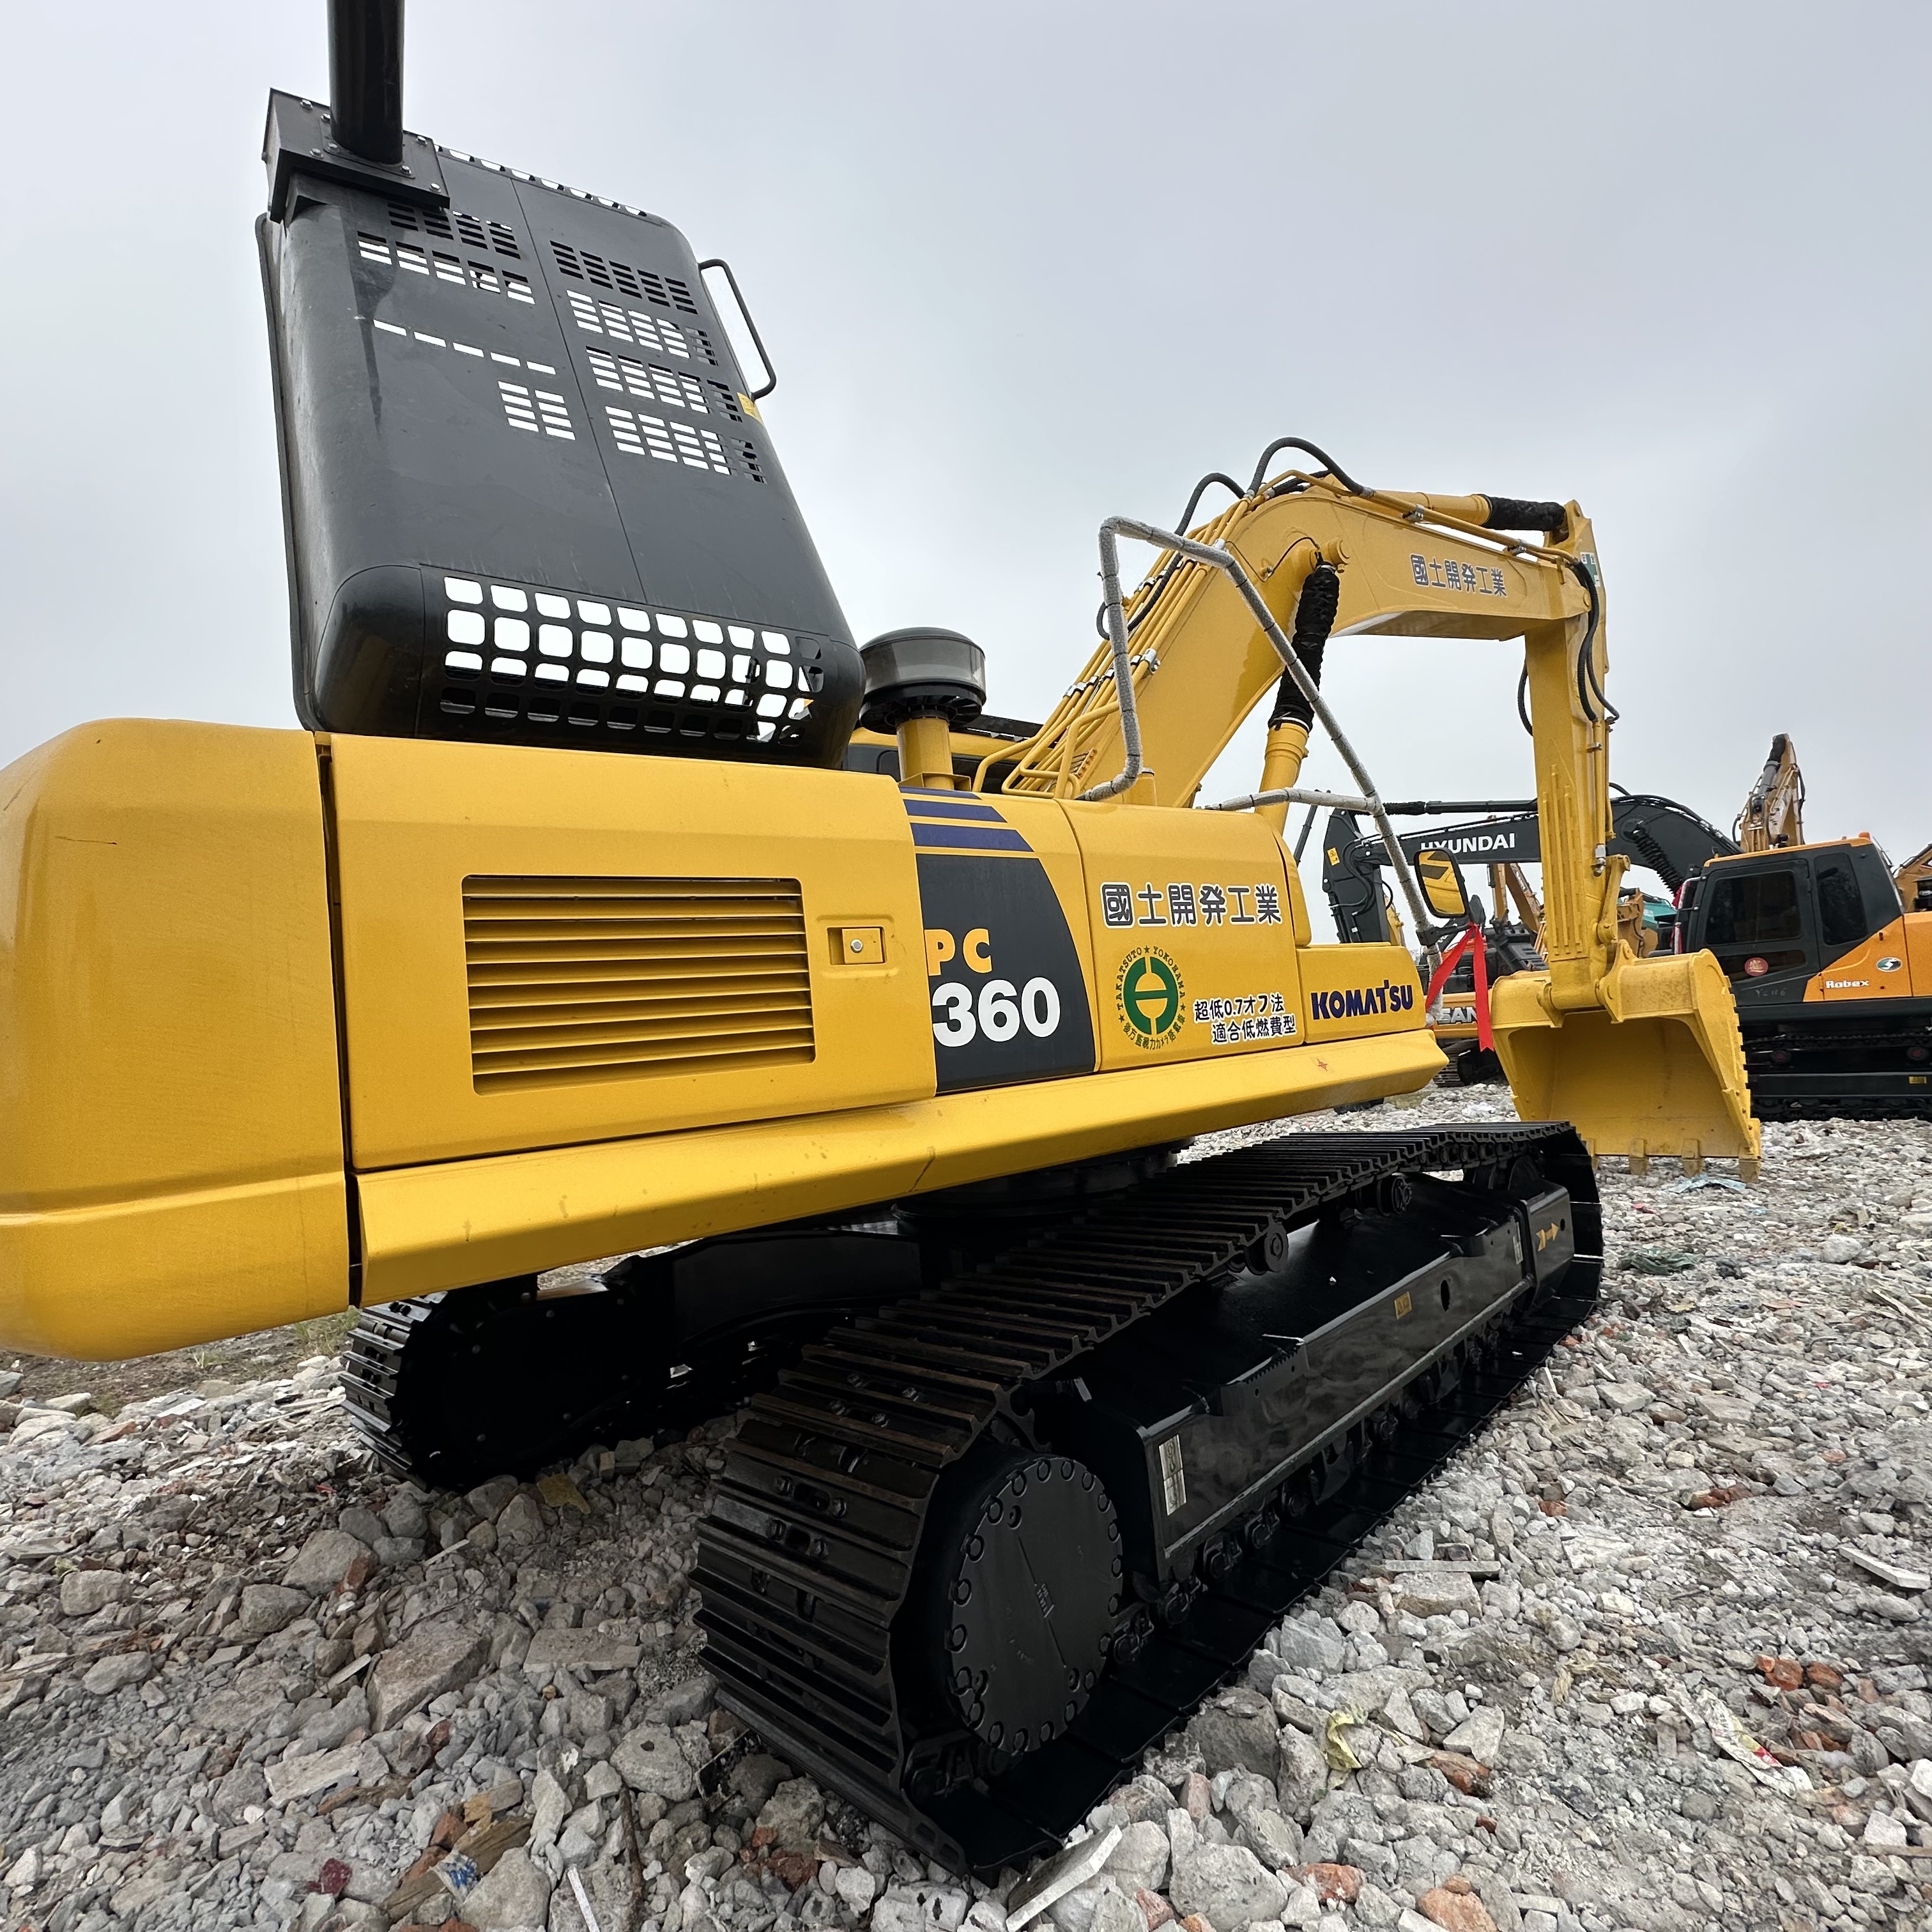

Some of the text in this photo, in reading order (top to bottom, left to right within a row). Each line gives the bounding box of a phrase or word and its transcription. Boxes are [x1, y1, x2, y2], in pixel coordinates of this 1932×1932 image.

[1101, 883, 1282, 926] 國土開発工業
[924, 928, 993, 976] PC
[1153, 946, 1186, 999] YOKOHAMA
[1310, 979, 1414, 1020] KOMATSU
[1825, 979, 1870, 989] Robex
[931, 976, 1061, 1048] 360
[1212, 1014, 1297, 1043] 適合低燃費型
